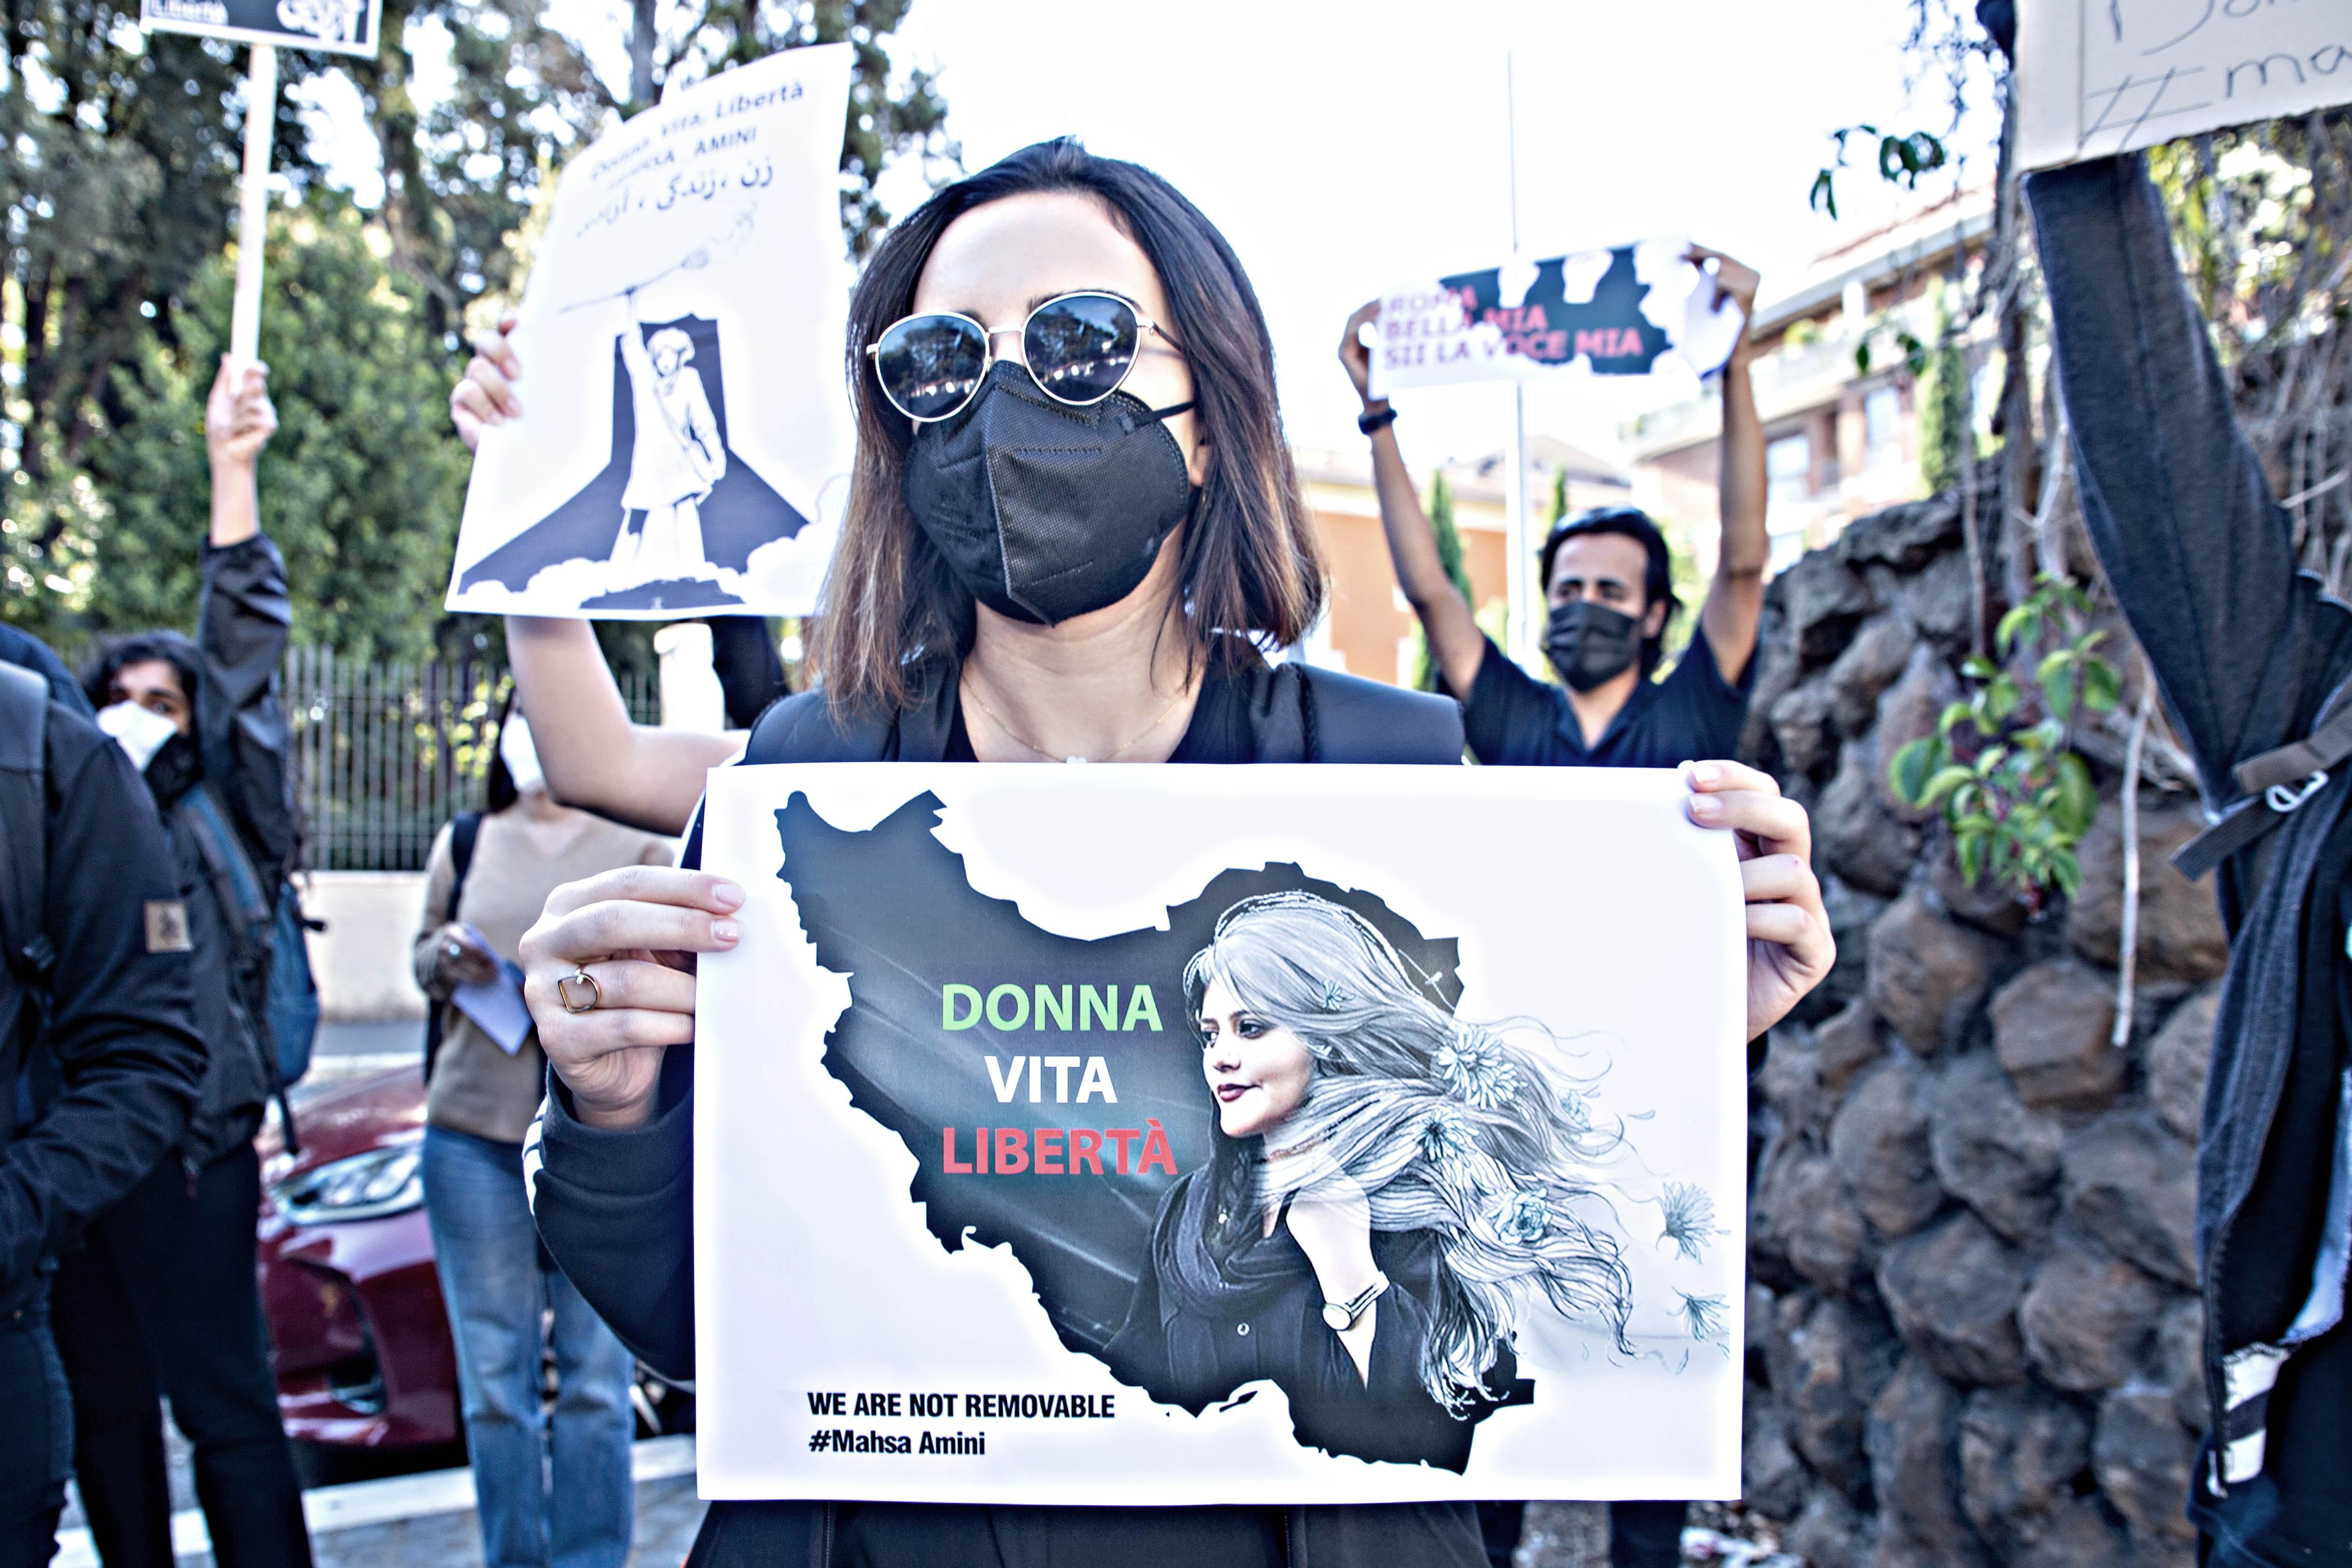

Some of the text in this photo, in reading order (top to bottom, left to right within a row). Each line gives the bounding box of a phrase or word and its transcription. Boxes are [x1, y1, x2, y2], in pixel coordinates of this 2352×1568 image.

[694, 126, 757, 156] AMINI
[1483, 304, 1548, 332] MIA
[1436, 341, 1470, 363] LA
[1575, 327, 1643, 358] MIA
[943, 984, 1163, 1031] DONNA
[984, 1056, 1118, 1103] VITA
[943, 1118, 1177, 1174] LIBERTÀ
[808, 1393, 1115, 1418] WE ARE NOT REMOVABLE
[808, 1429, 985, 1455] #Mahsa Amini
